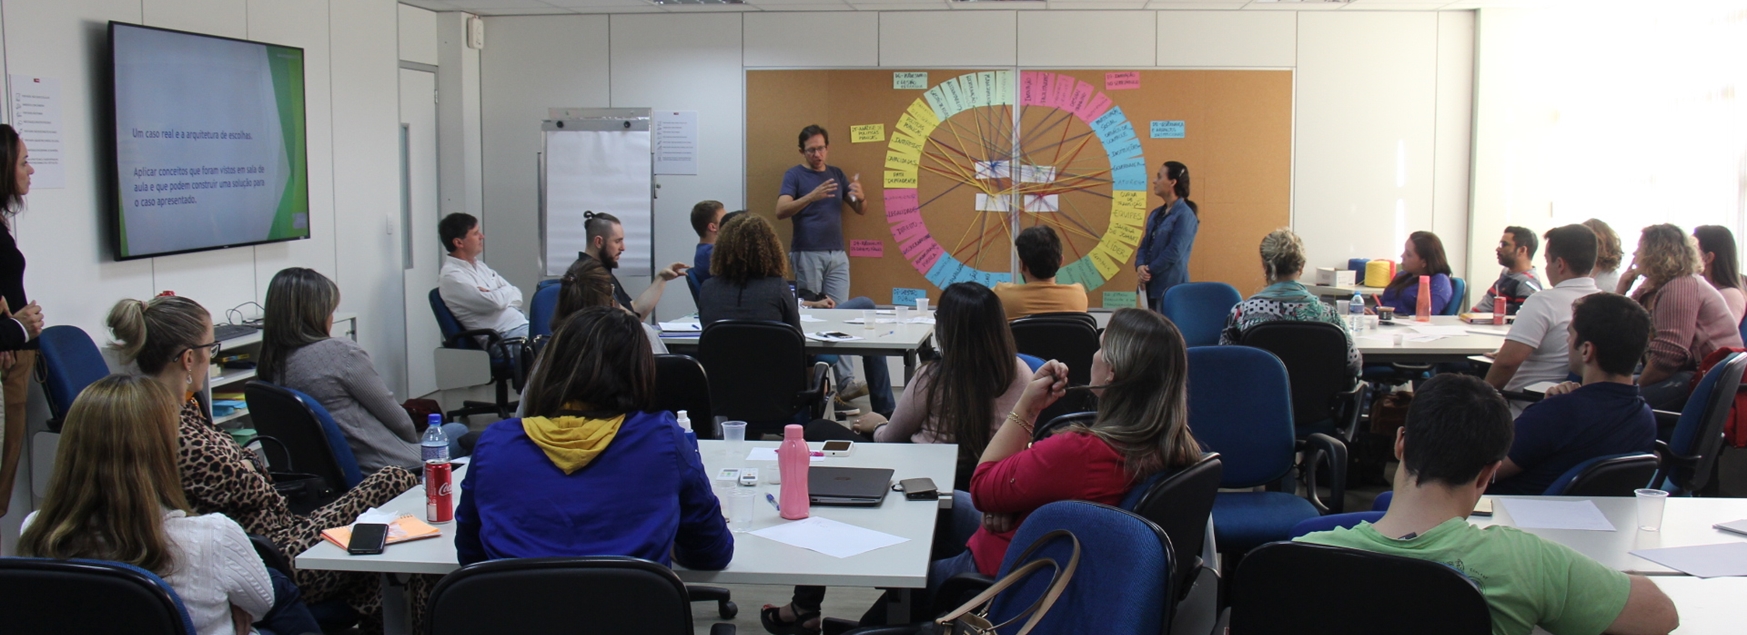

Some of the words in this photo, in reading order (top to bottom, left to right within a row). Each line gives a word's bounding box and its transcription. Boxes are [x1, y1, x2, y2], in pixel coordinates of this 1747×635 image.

[1101, 119, 1117, 131] SOCIAL
[132, 128, 144, 138] Um
[146, 131, 159, 139] caso
[162, 129, 174, 139] real
[186, 130, 219, 140] arquitetura
[221, 130, 227, 139] de
[229, 130, 253, 140] escolhas.
[134, 167, 157, 178] Aplicar
[159, 166, 188, 176] conceitos
[190, 168, 200, 177] que
[202, 166, 218, 175] foram
[220, 165, 236, 174] vistos
[247, 165, 257, 173] sala
[258, 164, 265, 173] de
[134, 182, 148, 192] aula
[156, 183, 168, 193] que
[170, 181, 190, 192] podem
[192, 180, 218, 189] construir
[232, 178, 252, 189] solução
[253, 179, 265, 188] para
[141, 198, 155, 206] caso
[157, 195, 197, 207] apresentado.
[1113, 210, 1142, 220] EQUIPES
[896, 222, 918, 235] DIREITO
[1106, 240, 1126, 257] LÍDER
